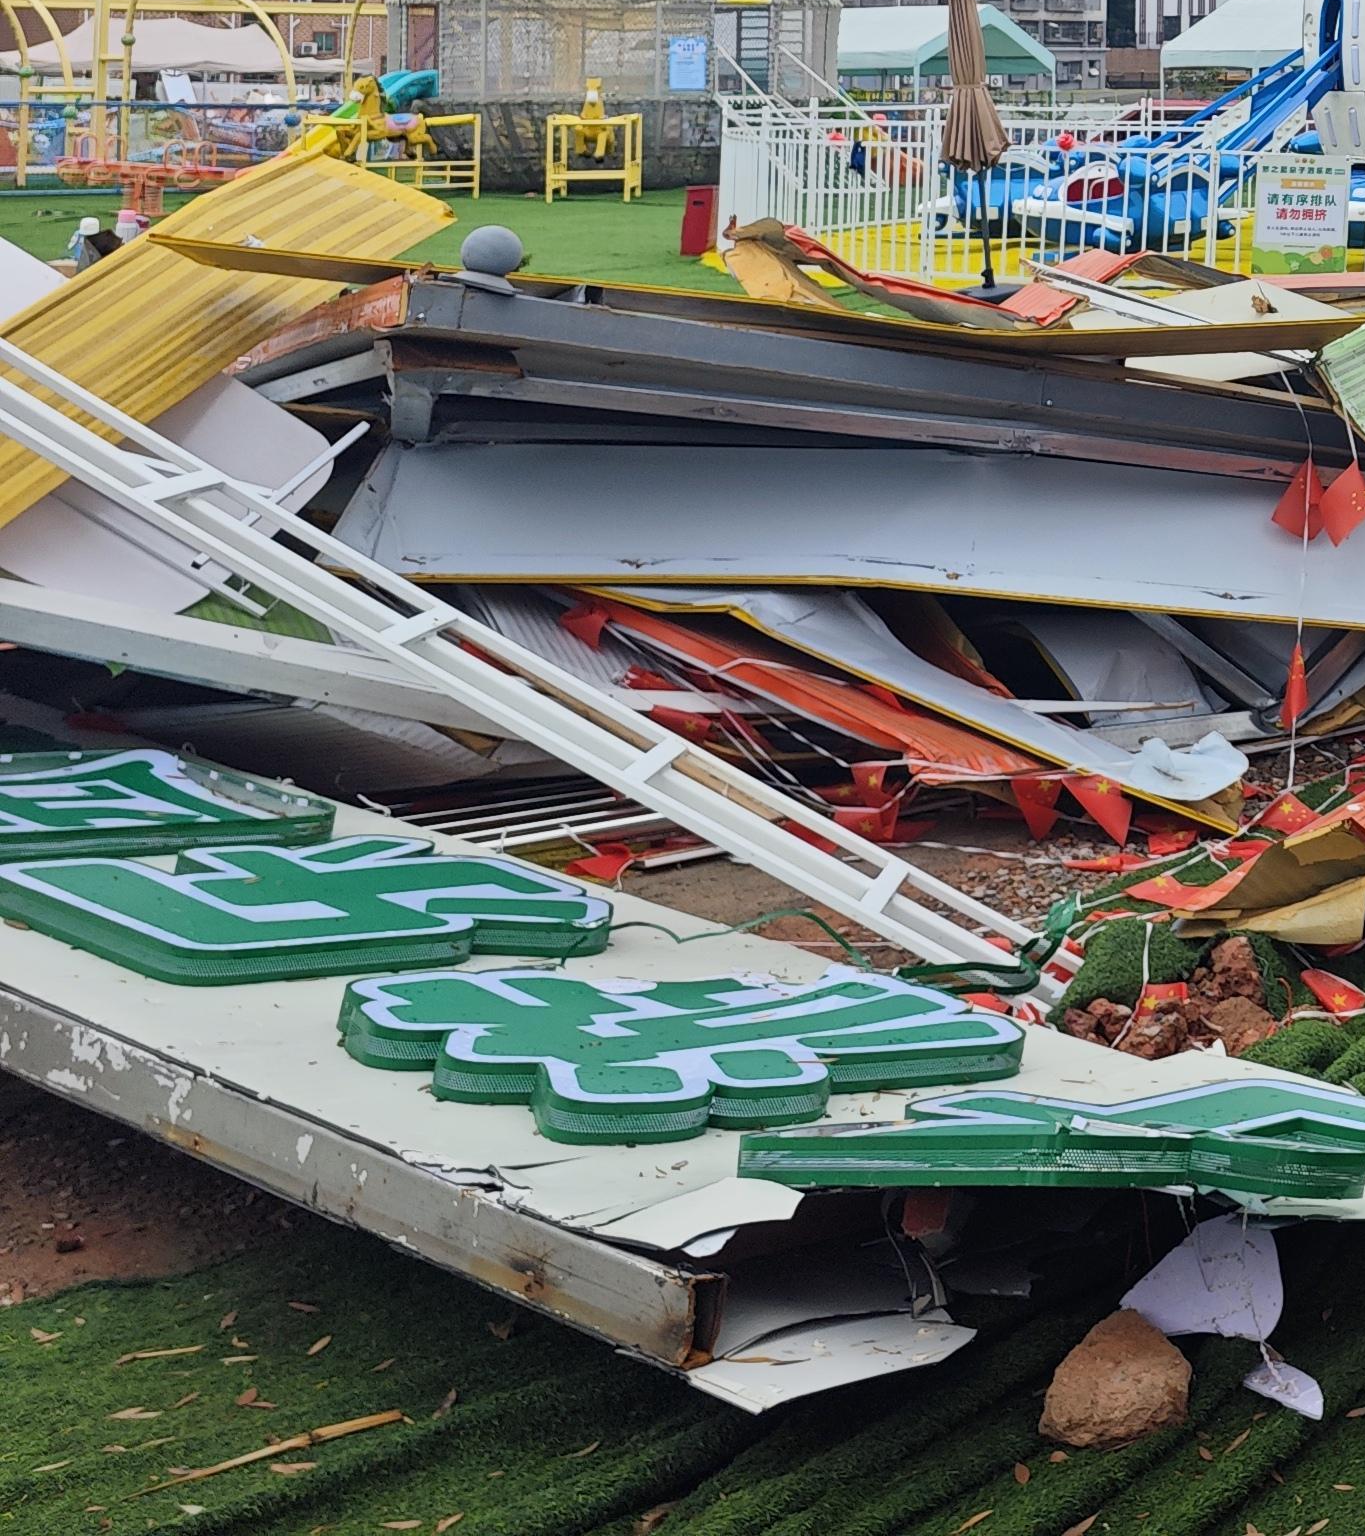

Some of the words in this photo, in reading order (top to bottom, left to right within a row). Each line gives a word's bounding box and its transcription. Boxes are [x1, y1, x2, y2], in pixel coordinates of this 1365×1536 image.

[1267, 193, 1337, 206] 请有序排队
[1275, 208, 1328, 221] 请勿拥挤
